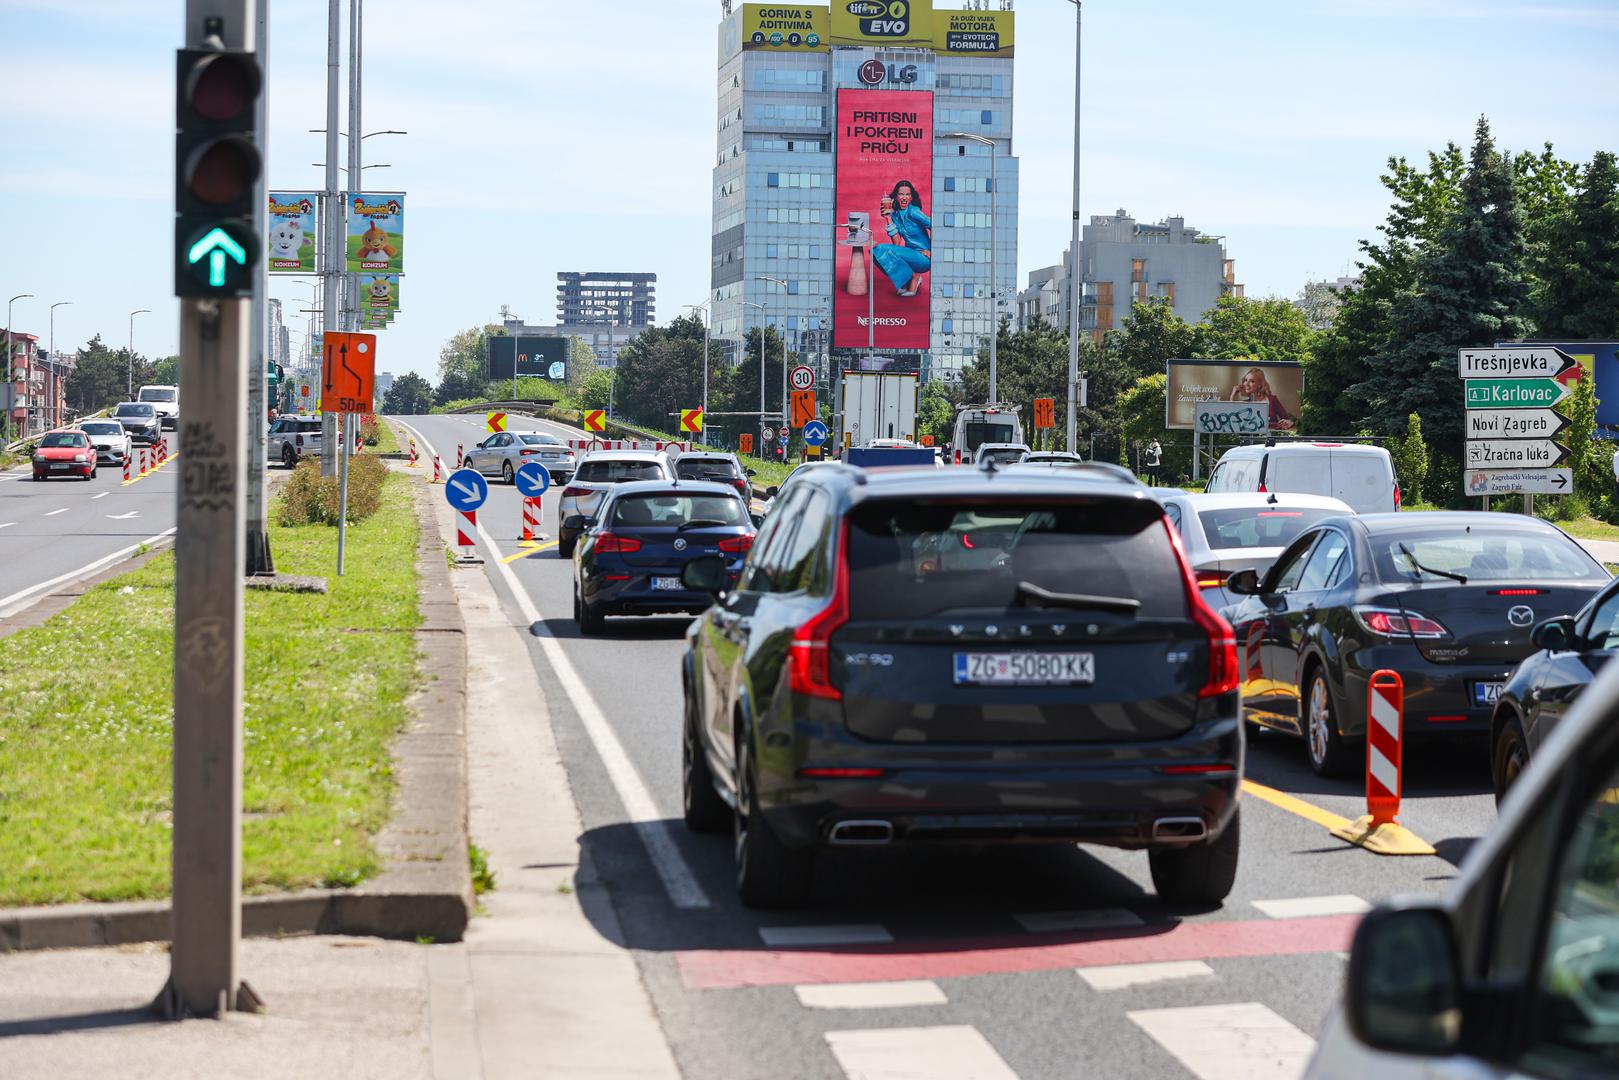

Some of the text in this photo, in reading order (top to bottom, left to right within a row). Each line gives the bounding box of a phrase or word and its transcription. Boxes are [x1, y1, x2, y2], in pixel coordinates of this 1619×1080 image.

[759, 8, 813, 20] GORIVA S
[759, 20, 813, 30] ADITIVIMA
[870, 20, 906, 34] EVO
[950, 22, 996, 31] MOTORA
[962, 33, 996, 41] EVOTECH
[949, 41, 996, 50] FORMULA
[888, 64, 918, 84] LG
[853, 111, 917, 123] PRITISNI
[847, 126, 923, 139] I POKRENI
[861, 139, 909, 154] PRIČU
[1465, 353, 1548, 374] Trešnjevka
[795, 372, 810, 385] 30
[1492, 385, 1553, 401] Karlovac
[1472, 415, 1547, 433] Novi Zagreb
[1526, 447, 1549, 461] luka
[1491, 473, 1548, 484] Zagrebački Velesajam
[1491, 483, 1523, 493] Zagreb Fair
[949, 623, 1099, 636] VOLVO
[971, 655, 996, 678] ZG
